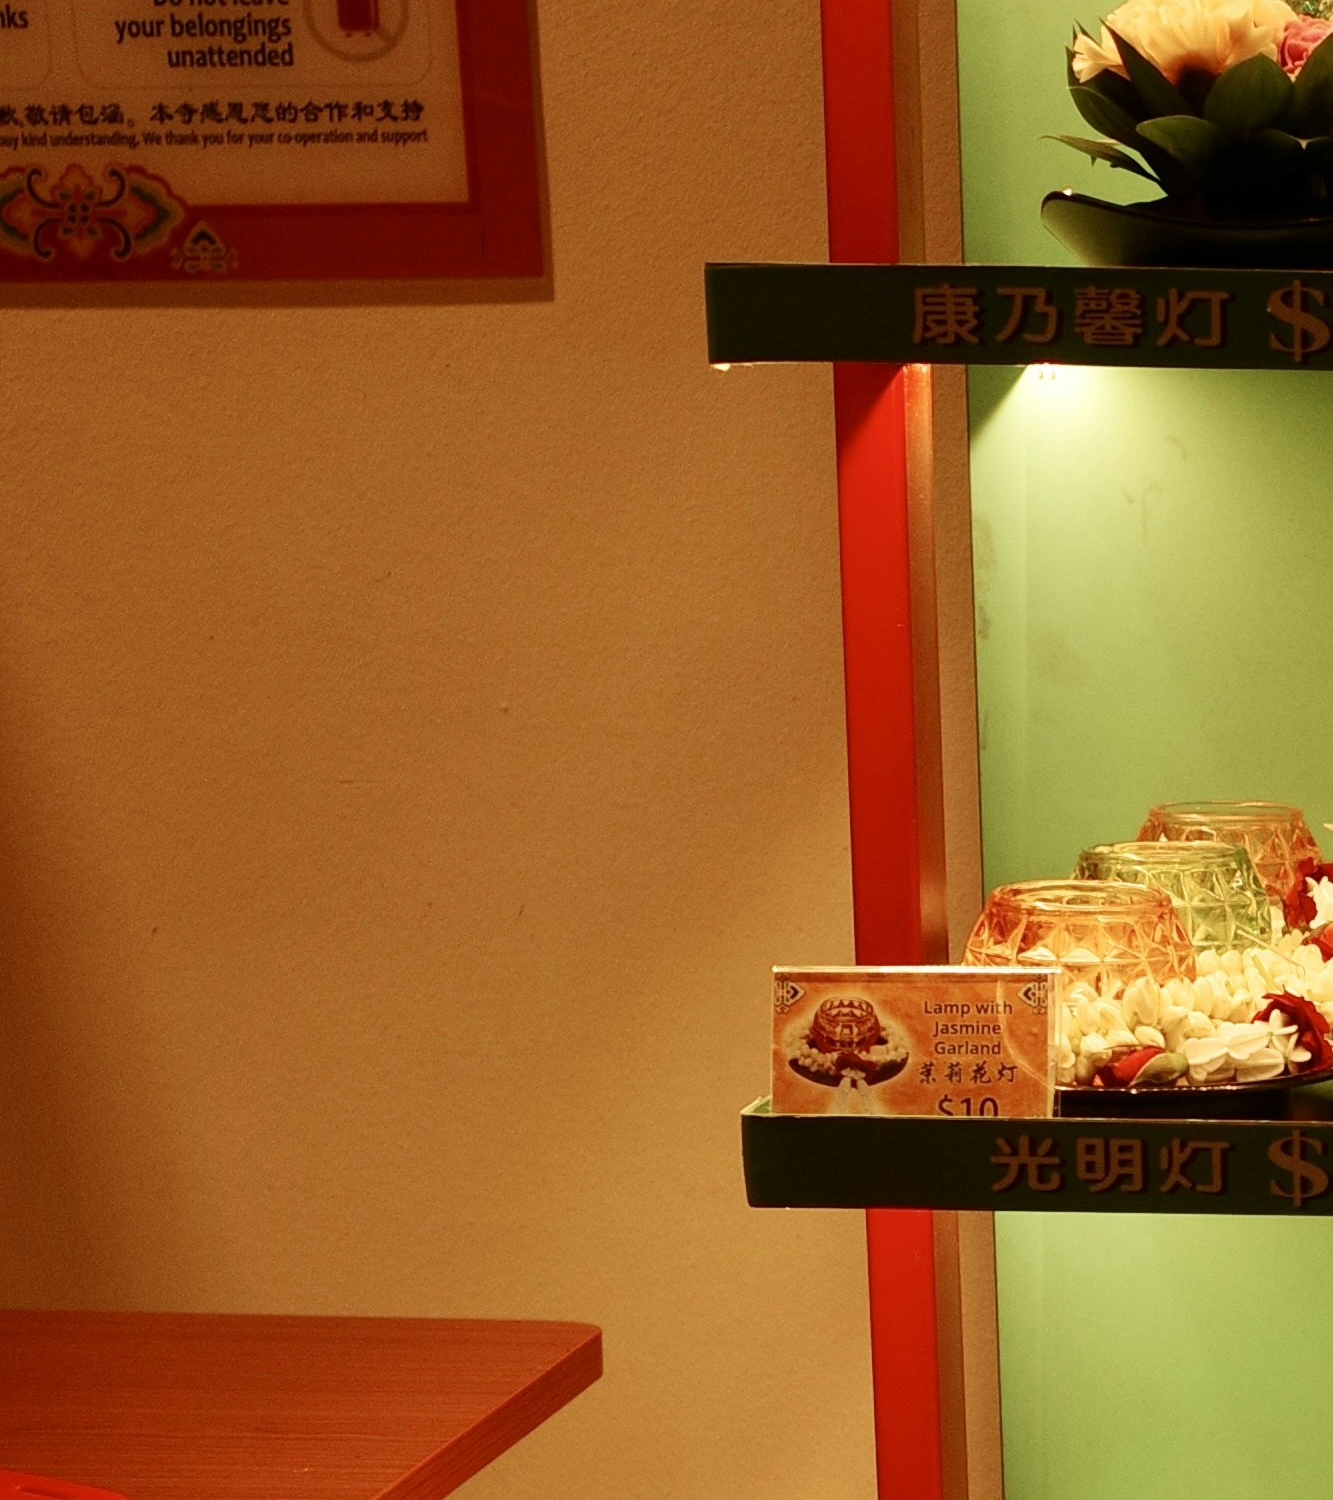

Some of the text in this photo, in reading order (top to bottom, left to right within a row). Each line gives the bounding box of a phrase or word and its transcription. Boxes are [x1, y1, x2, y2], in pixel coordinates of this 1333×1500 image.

[115, 13, 291, 45] your belongings
[167, 42, 294, 68] unattended
[226, 128, 428, 148] for and support
[912, 284, 1232, 350] 康乃馨灯
[923, 1000, 1013, 1018] Lamp with
[932, 1022, 1003, 1038] Jasmine
[934, 1040, 1002, 1056] Garland
[918, 1059, 1019, 1085] 茉莉花灯
[937, 1093, 1000, 1117] $10
[990, 1136, 1231, 1197] 光明灯
